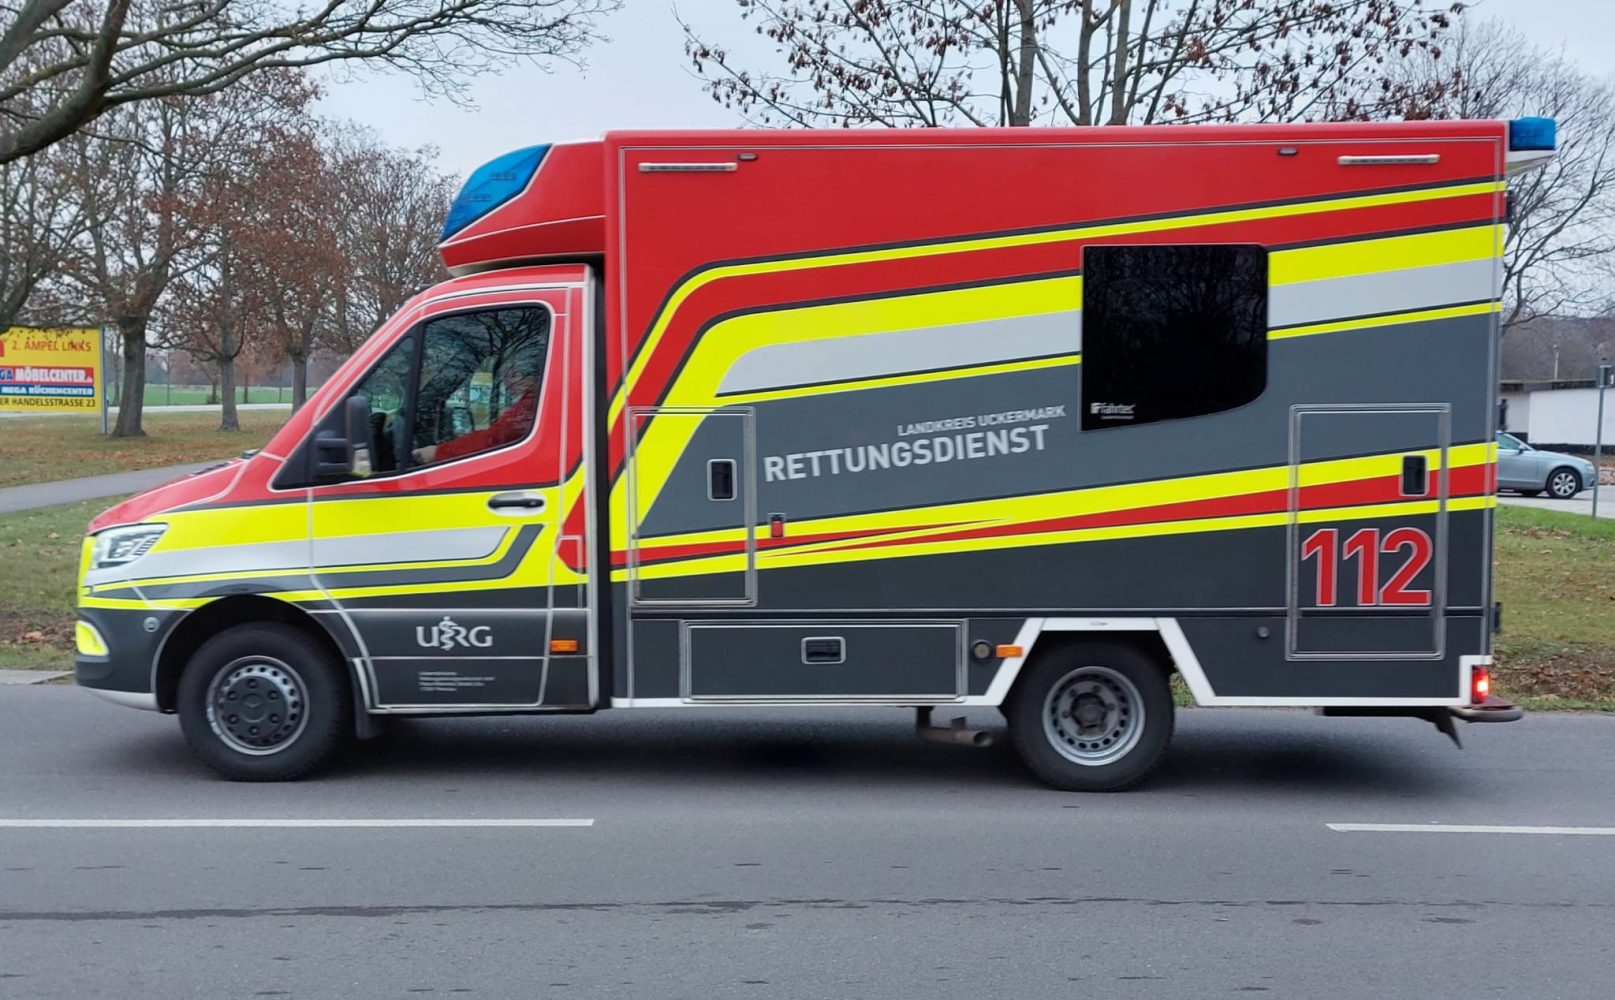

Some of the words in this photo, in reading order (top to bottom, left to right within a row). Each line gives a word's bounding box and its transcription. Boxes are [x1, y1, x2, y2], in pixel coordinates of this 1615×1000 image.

[24, 340, 58, 352] AMPEL
[62, 340, 92, 352] LINKS
[11, 398, 84, 407] HANDELSSTRASSE
[897, 416, 976, 436] LANDKREIS
[977, 405, 1067, 427] UCKERMARK
[763, 424, 1049, 482] RETTUNGSDIENST
[1301, 526, 1433, 606] 112
